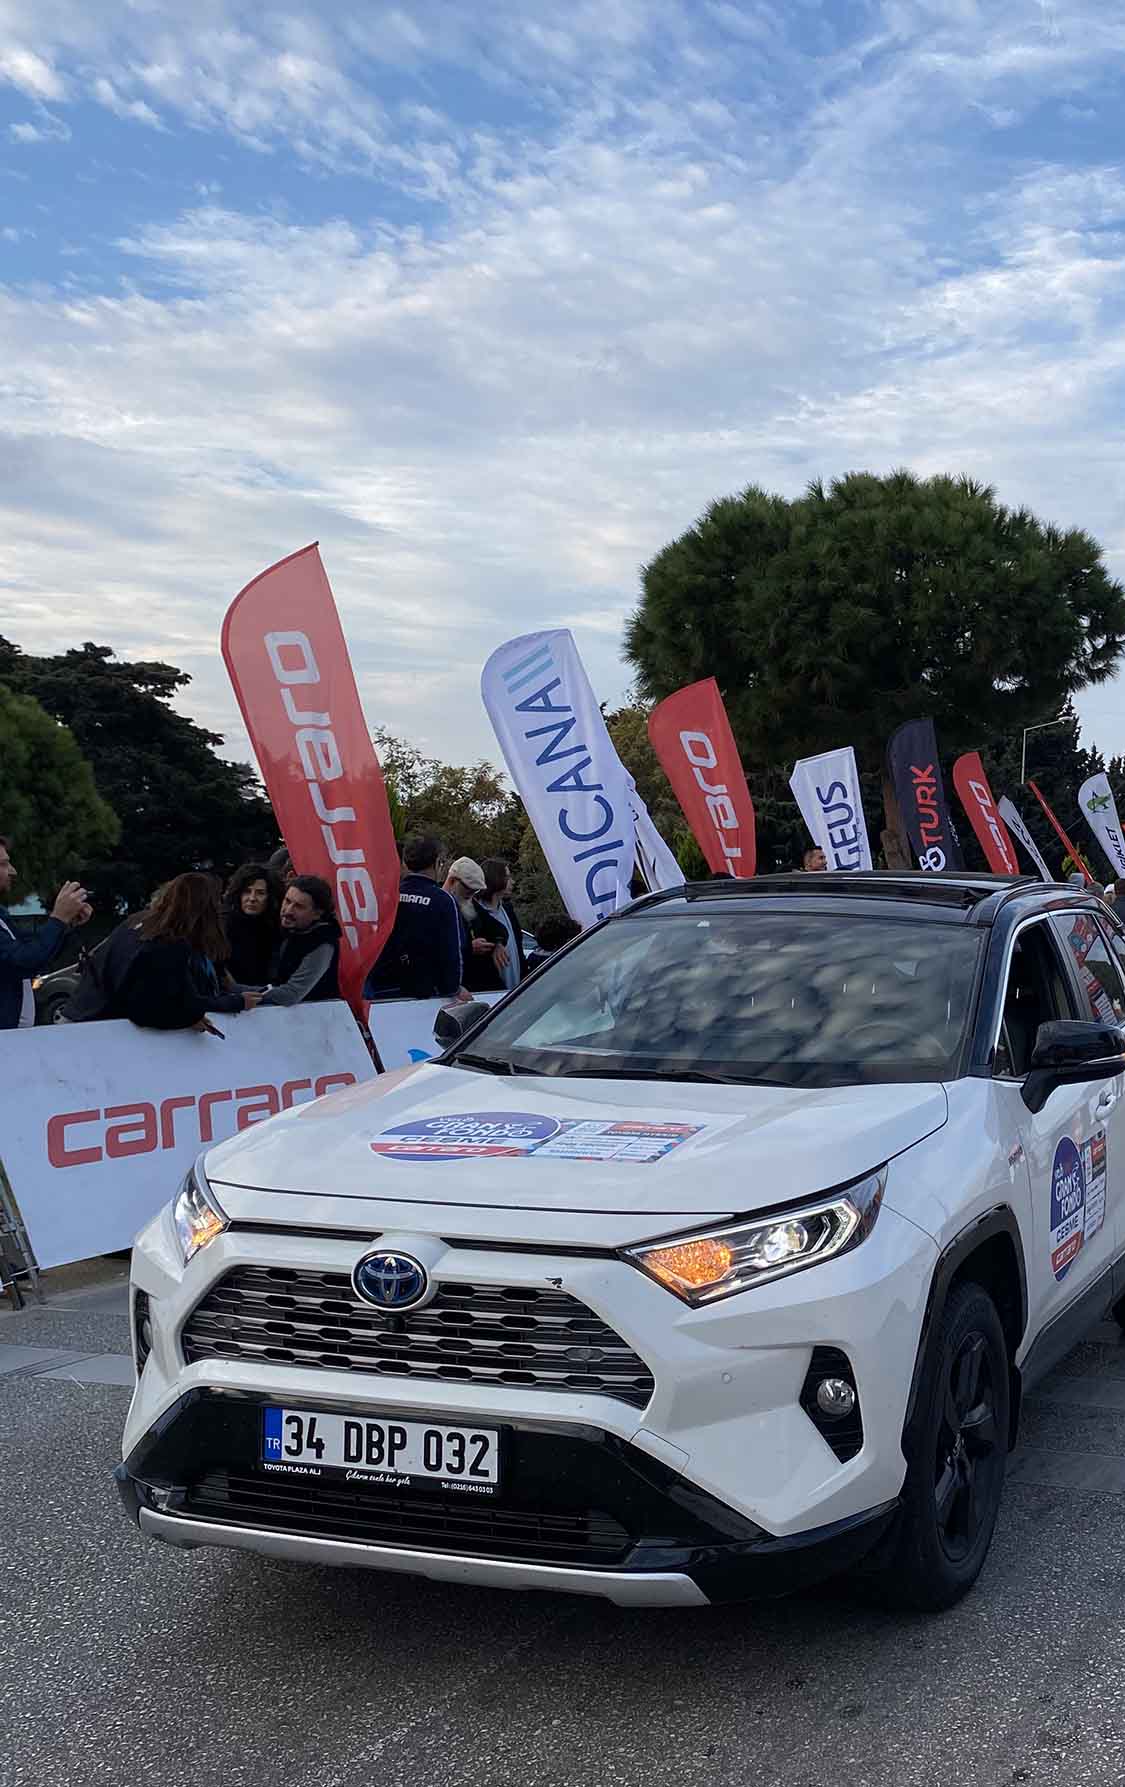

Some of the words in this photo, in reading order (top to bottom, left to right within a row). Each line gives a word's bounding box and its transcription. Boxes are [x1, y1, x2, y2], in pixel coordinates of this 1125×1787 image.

[515, 677, 625, 920] DICANA
[263, 1463, 288, 1472] TOYOTA
[288, 1466, 308, 1474] PLAZA
[266, 1437, 281, 1450] TR
[284, 1415, 325, 1459] 34
[343, 1420, 408, 1467] DBP
[423, 1429, 490, 1477] 032
